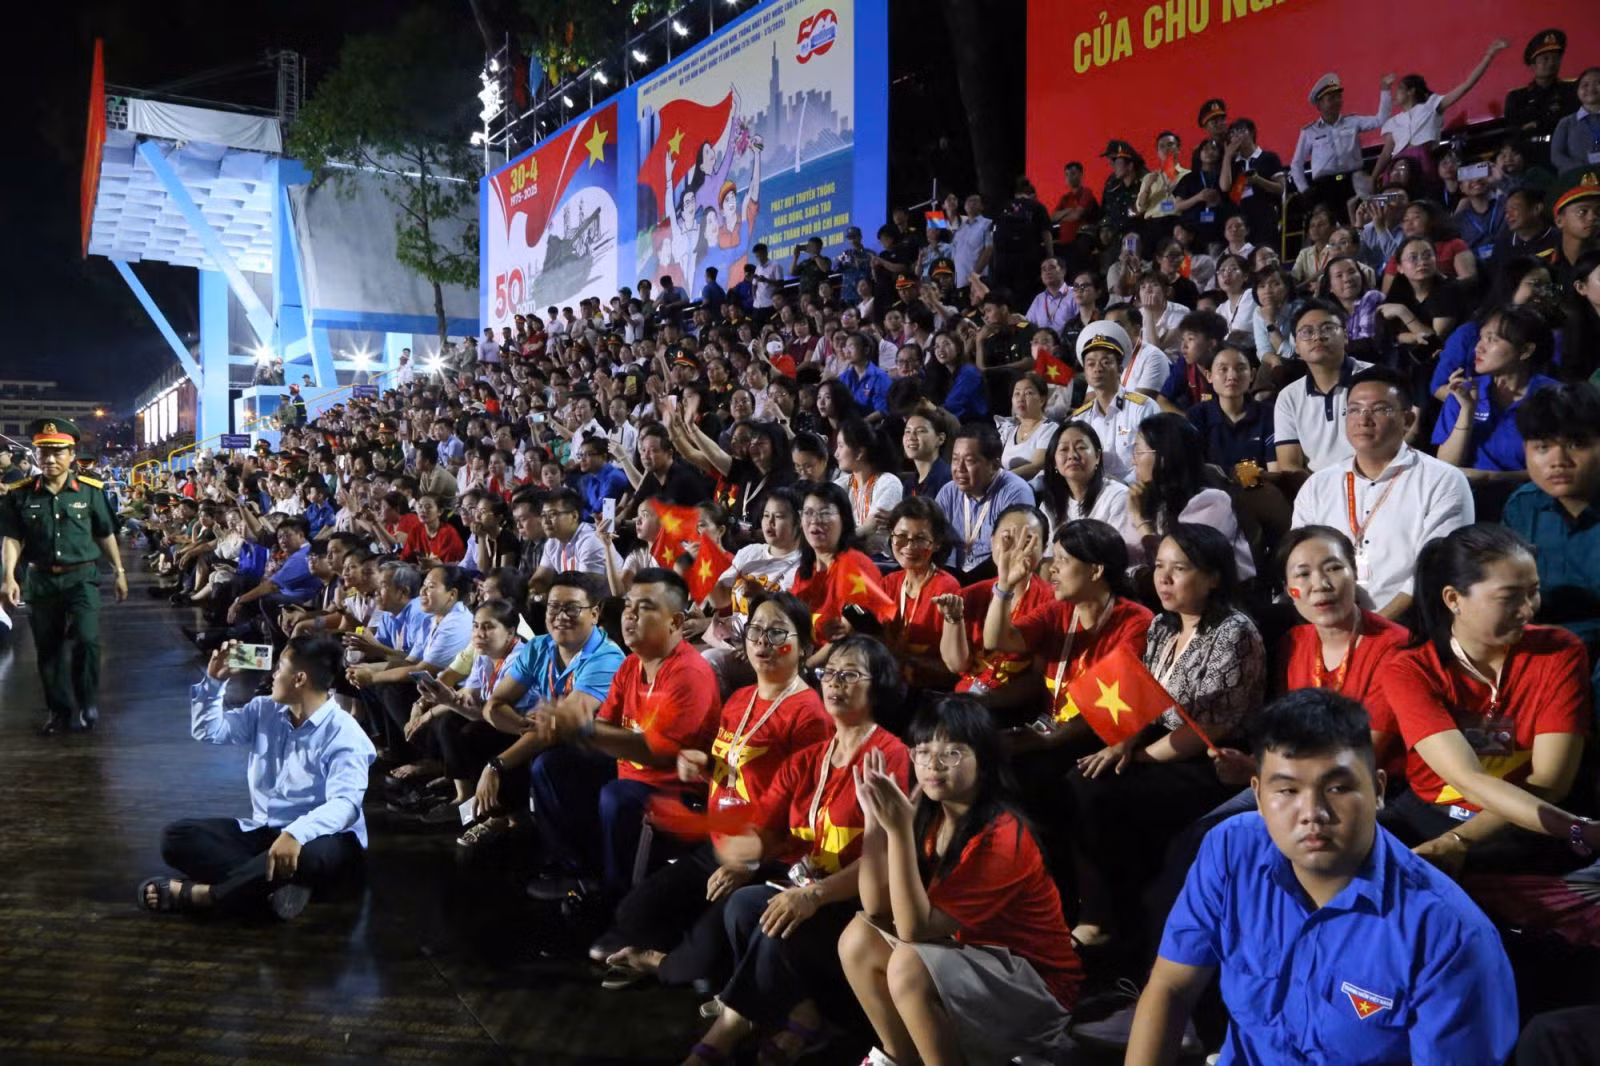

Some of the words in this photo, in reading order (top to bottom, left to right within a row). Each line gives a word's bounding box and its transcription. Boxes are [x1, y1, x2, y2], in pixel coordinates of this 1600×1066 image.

[1074, 11, 1133, 73] CỦA
[511, 156, 538, 194] 30-4
[495, 267, 524, 319] 50
